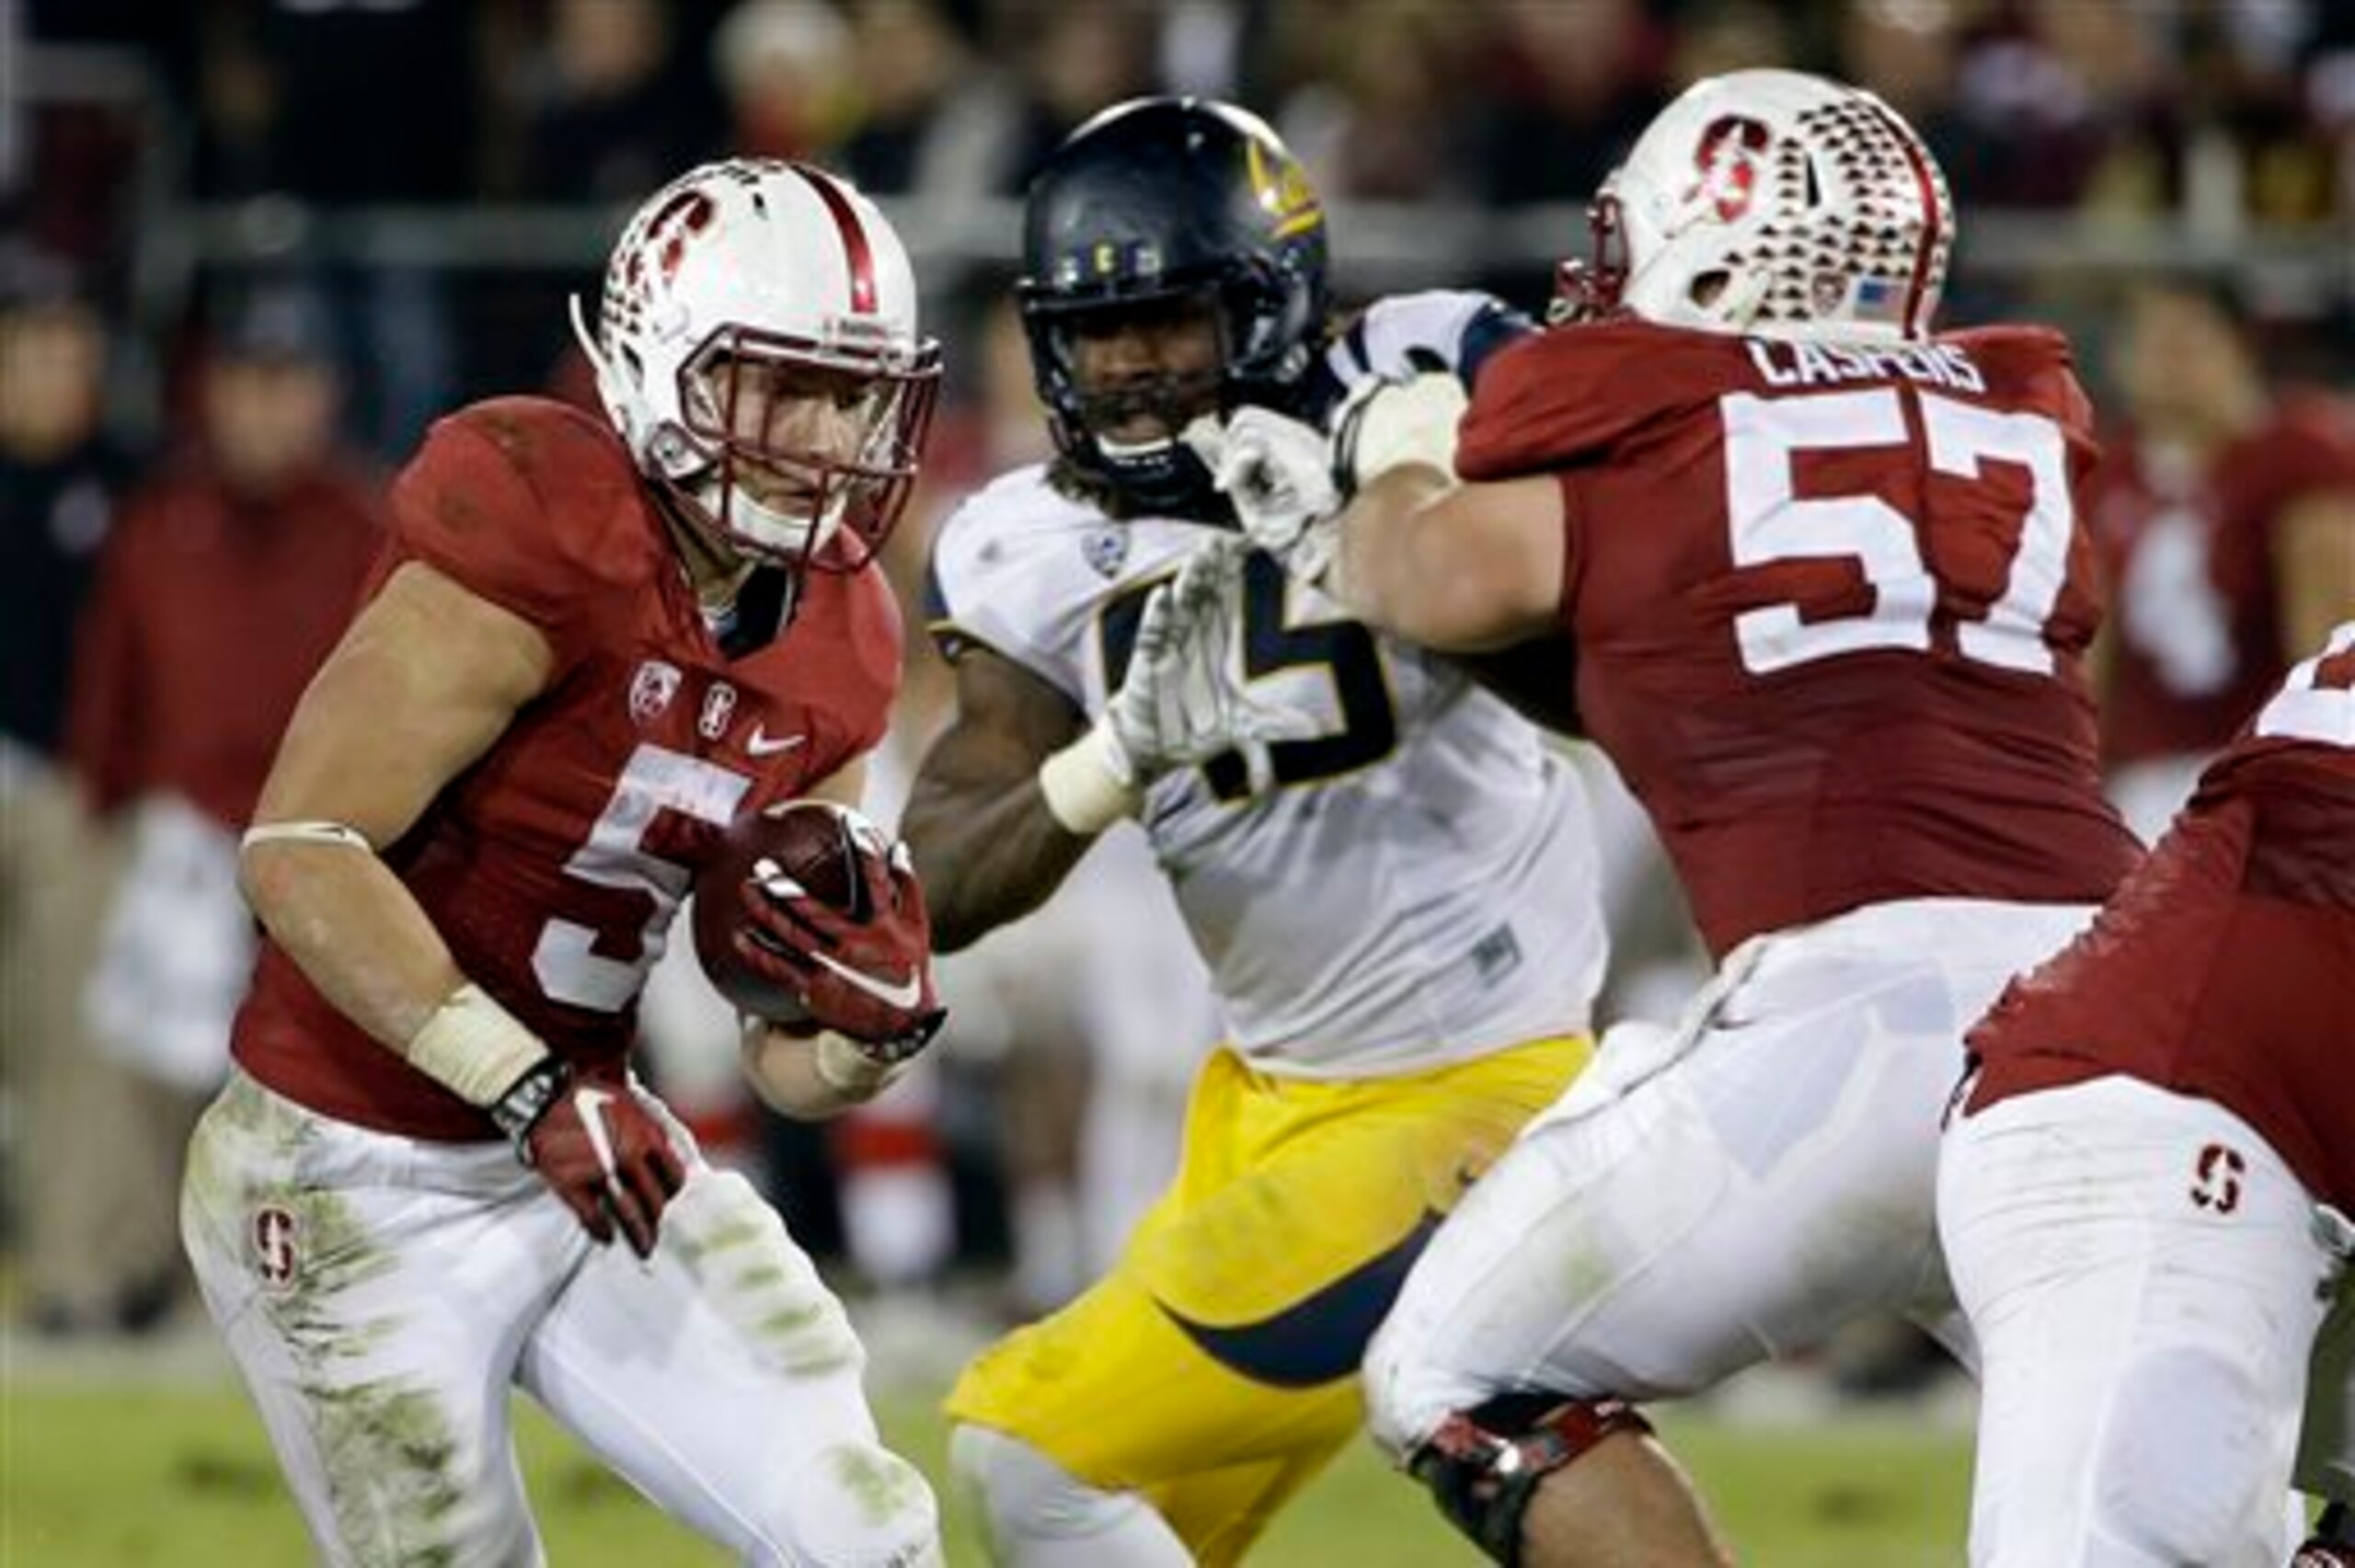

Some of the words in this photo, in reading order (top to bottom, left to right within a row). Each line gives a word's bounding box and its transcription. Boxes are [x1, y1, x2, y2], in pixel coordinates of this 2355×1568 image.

[1719, 387, 2074, 677] 57
[1098, 546, 1396, 803] 5
[530, 743, 753, 1013] 5
